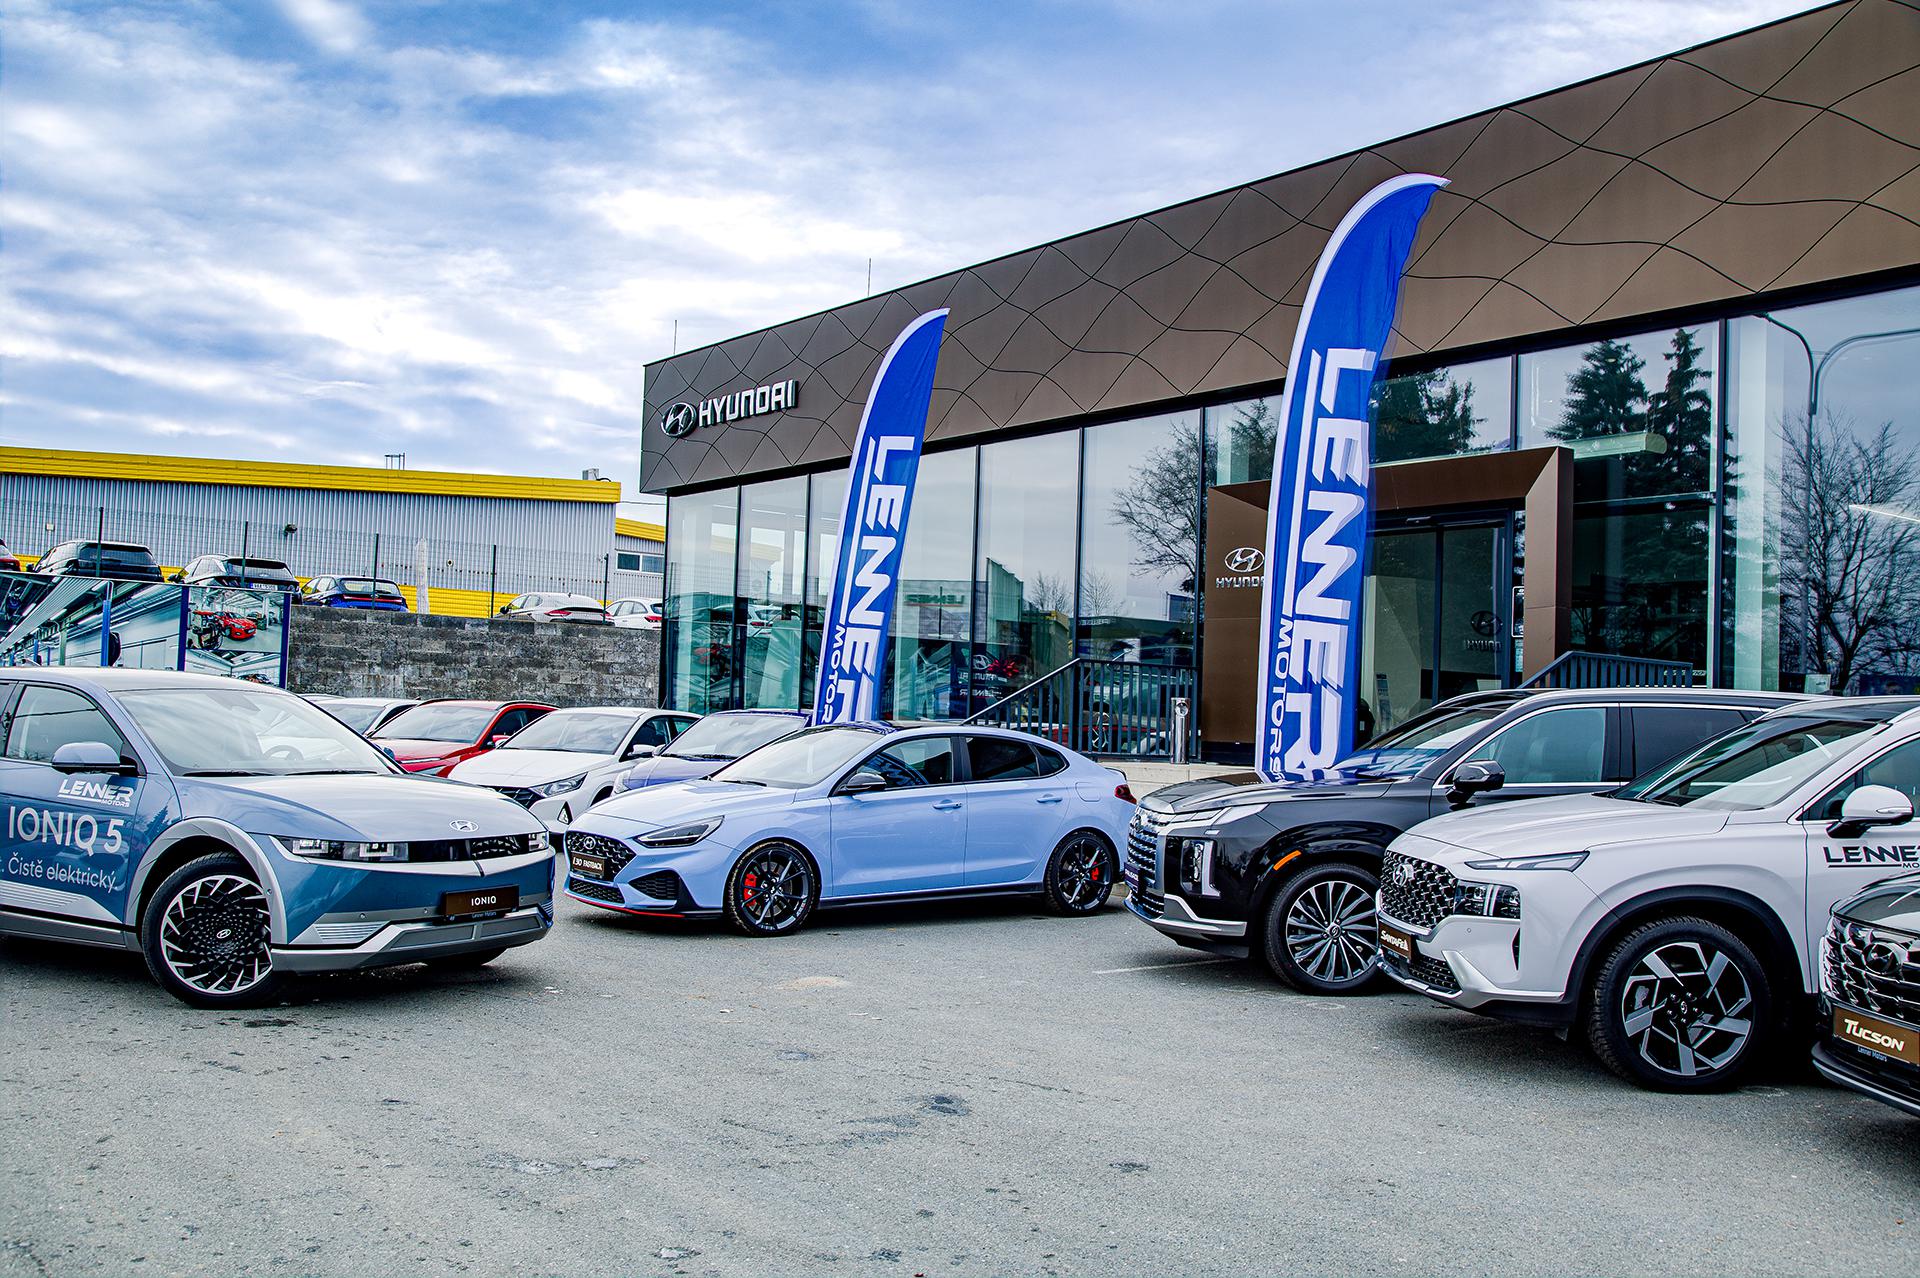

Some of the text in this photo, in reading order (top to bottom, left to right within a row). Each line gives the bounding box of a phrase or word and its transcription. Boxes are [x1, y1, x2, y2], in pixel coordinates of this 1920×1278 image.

[699, 379, 797, 427] HYUNDAI
[1284, 348, 1376, 781] LENNER
[58, 779, 134, 802] LENNER
[100, 799, 130, 808] MOTORS
[9, 806, 124, 856] IONIQ 5
[8, 851, 43, 879] Čistě
[1822, 845, 1920, 863] LENNE
